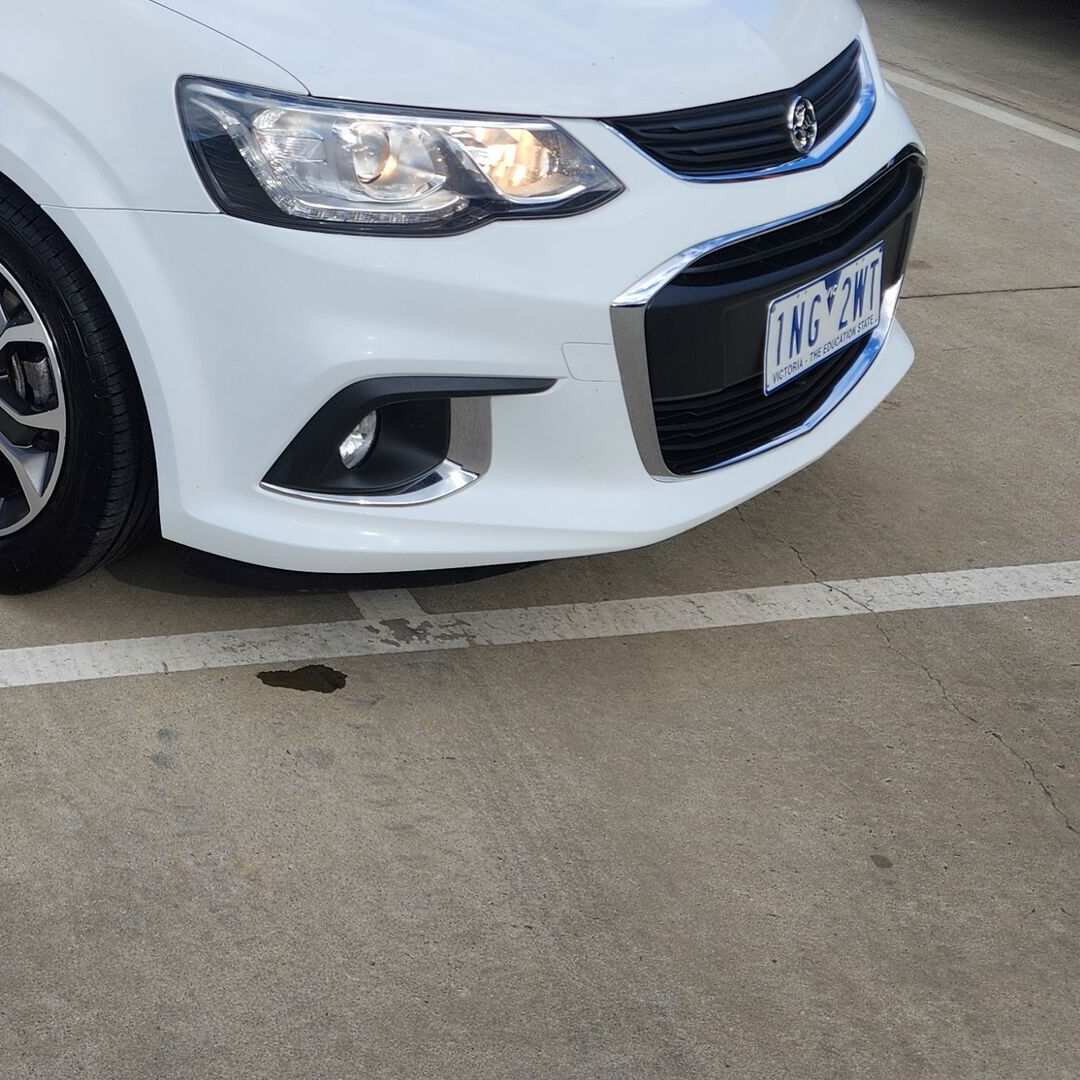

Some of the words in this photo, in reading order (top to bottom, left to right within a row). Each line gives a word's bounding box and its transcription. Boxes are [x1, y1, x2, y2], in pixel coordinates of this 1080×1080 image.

[772, 358, 804, 383] VICTORIA
[809, 346, 823, 363] THE
[823, 328, 856, 354] EDUCATION
[857, 314, 874, 335] STATE
[776, 293, 822, 366] 1NG
[838, 258, 879, 330] 2WT
